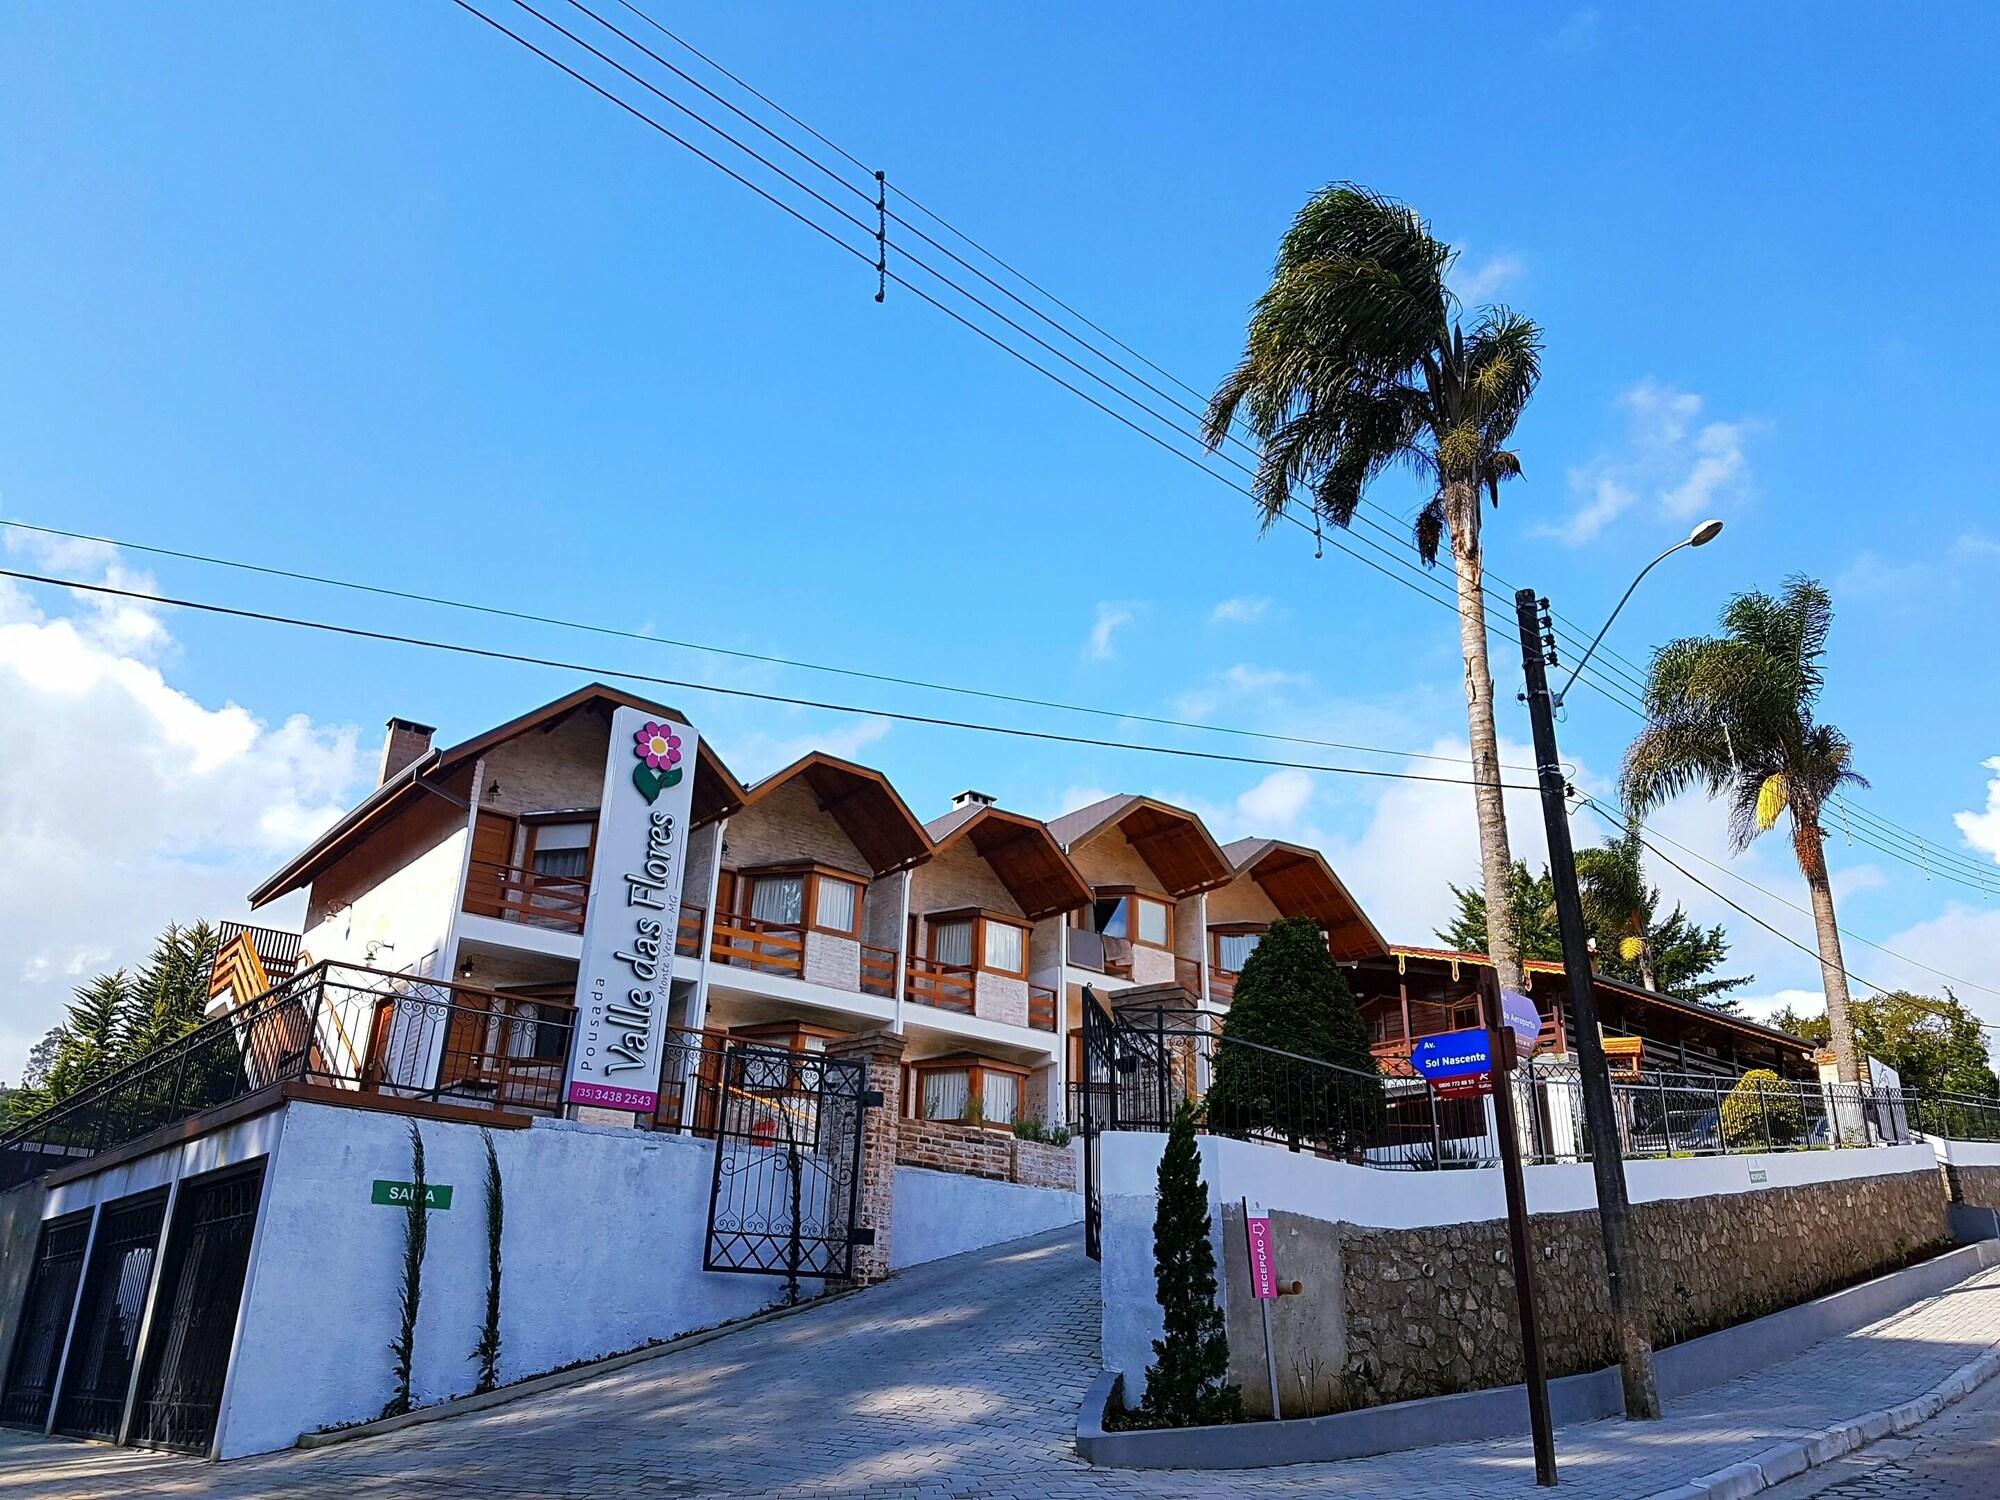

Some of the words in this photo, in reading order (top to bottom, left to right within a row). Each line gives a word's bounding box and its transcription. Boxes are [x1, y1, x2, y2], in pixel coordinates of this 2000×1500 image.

[624, 811, 675, 910] Flores
[668, 895, 678, 914] MG
[614, 917, 662, 981] das
[663, 927, 674, 958] Verde
[659, 961, 670, 996] Monte
[581, 978, 605, 1071] Pousada
[605, 988, 655, 1076] Valle
[1511, 1014, 1536, 1029] Aeroporto
[1425, 1059, 1440, 1068] Sol
[1442, 1053, 1486, 1066] Nascente
[576, 1087, 595, 1099] (35)
[594, 1089, 622, 1103] 3438
[624, 1093, 652, 1106] 2543
[389, 1185, 435, 1203] SAÍA
[1257, 1239, 1270, 1294] RECEPÇÃO
